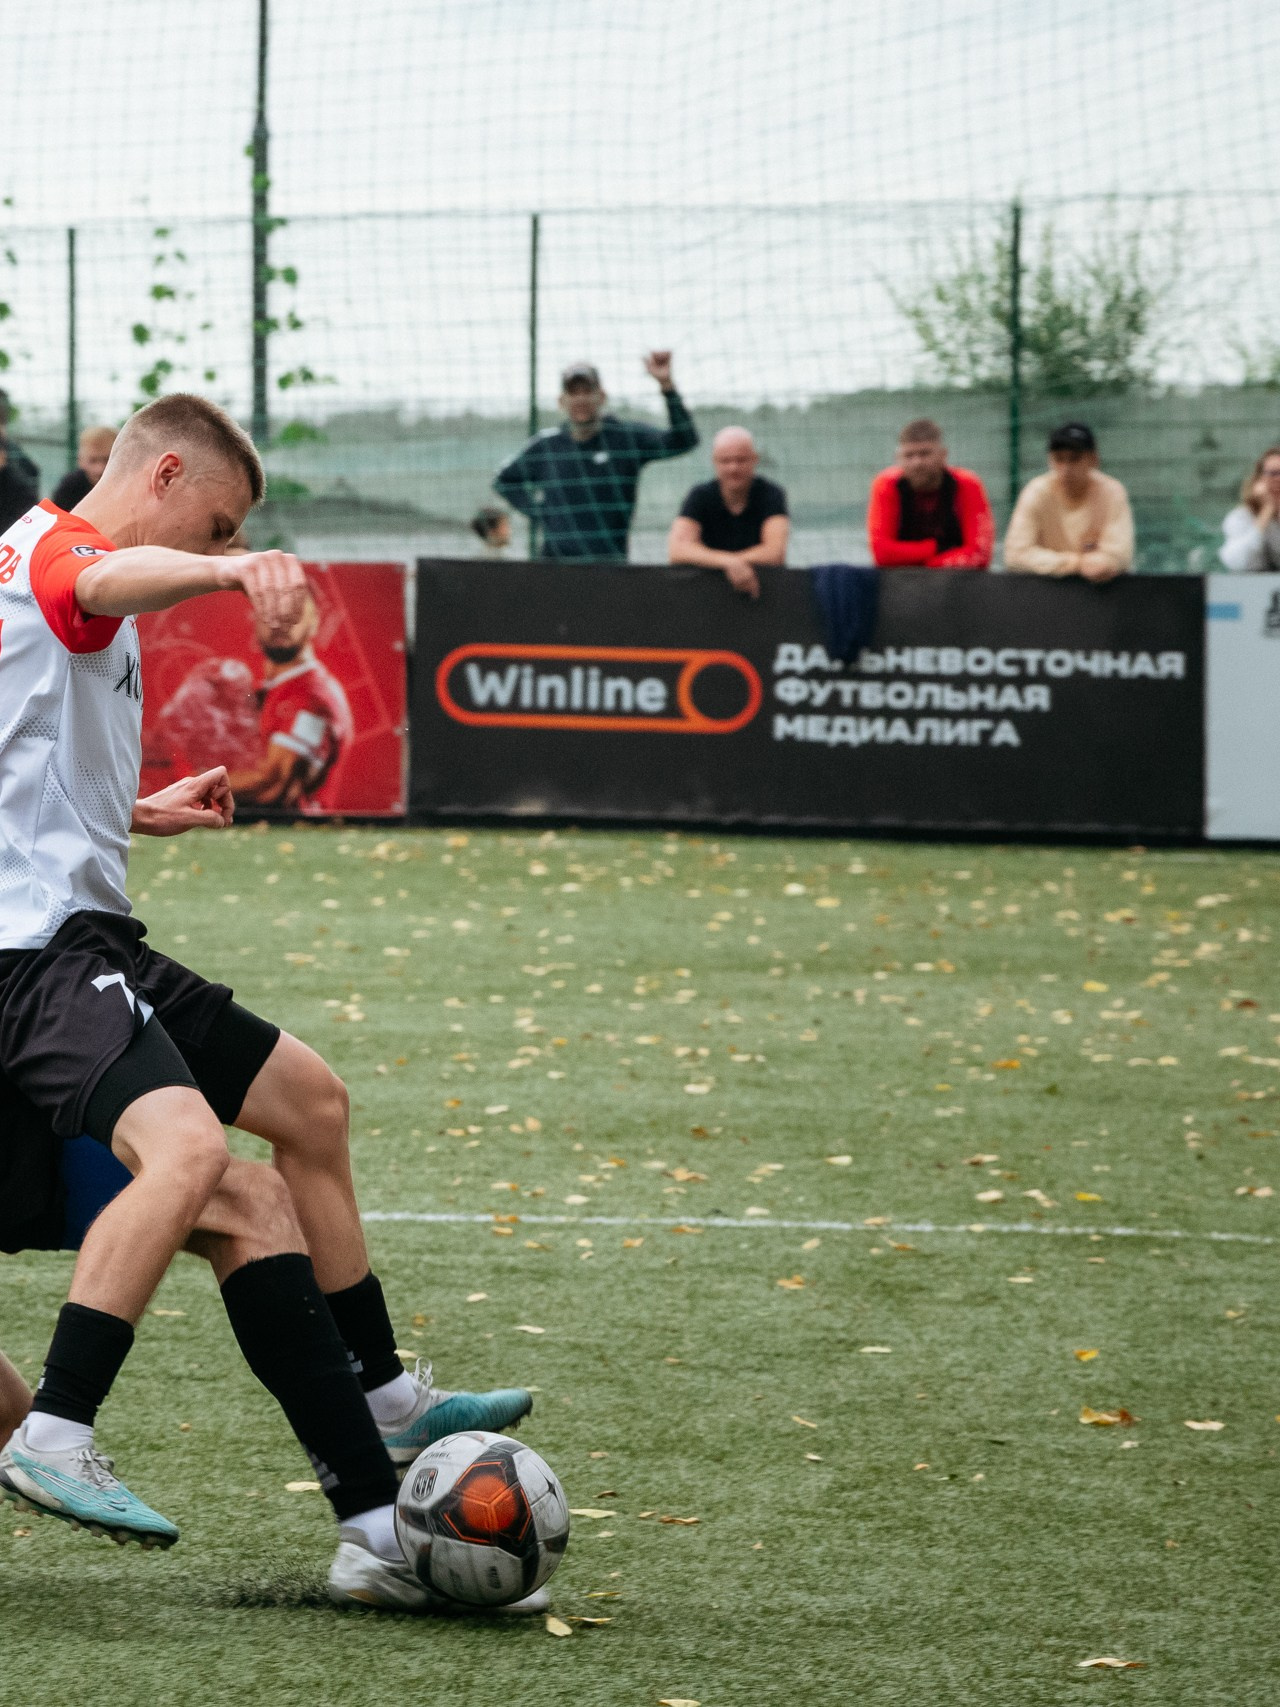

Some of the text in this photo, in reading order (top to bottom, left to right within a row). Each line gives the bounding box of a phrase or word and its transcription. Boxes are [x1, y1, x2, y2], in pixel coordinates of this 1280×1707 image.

[773, 643, 1186, 680] ДАЬНЕВОСТОЧНАЯ
[464, 662, 668, 713] Winline
[773, 679, 1051, 712] ФУТБОЛЬНАЯ
[773, 714, 1021, 748] МЕДИАЛИГА
